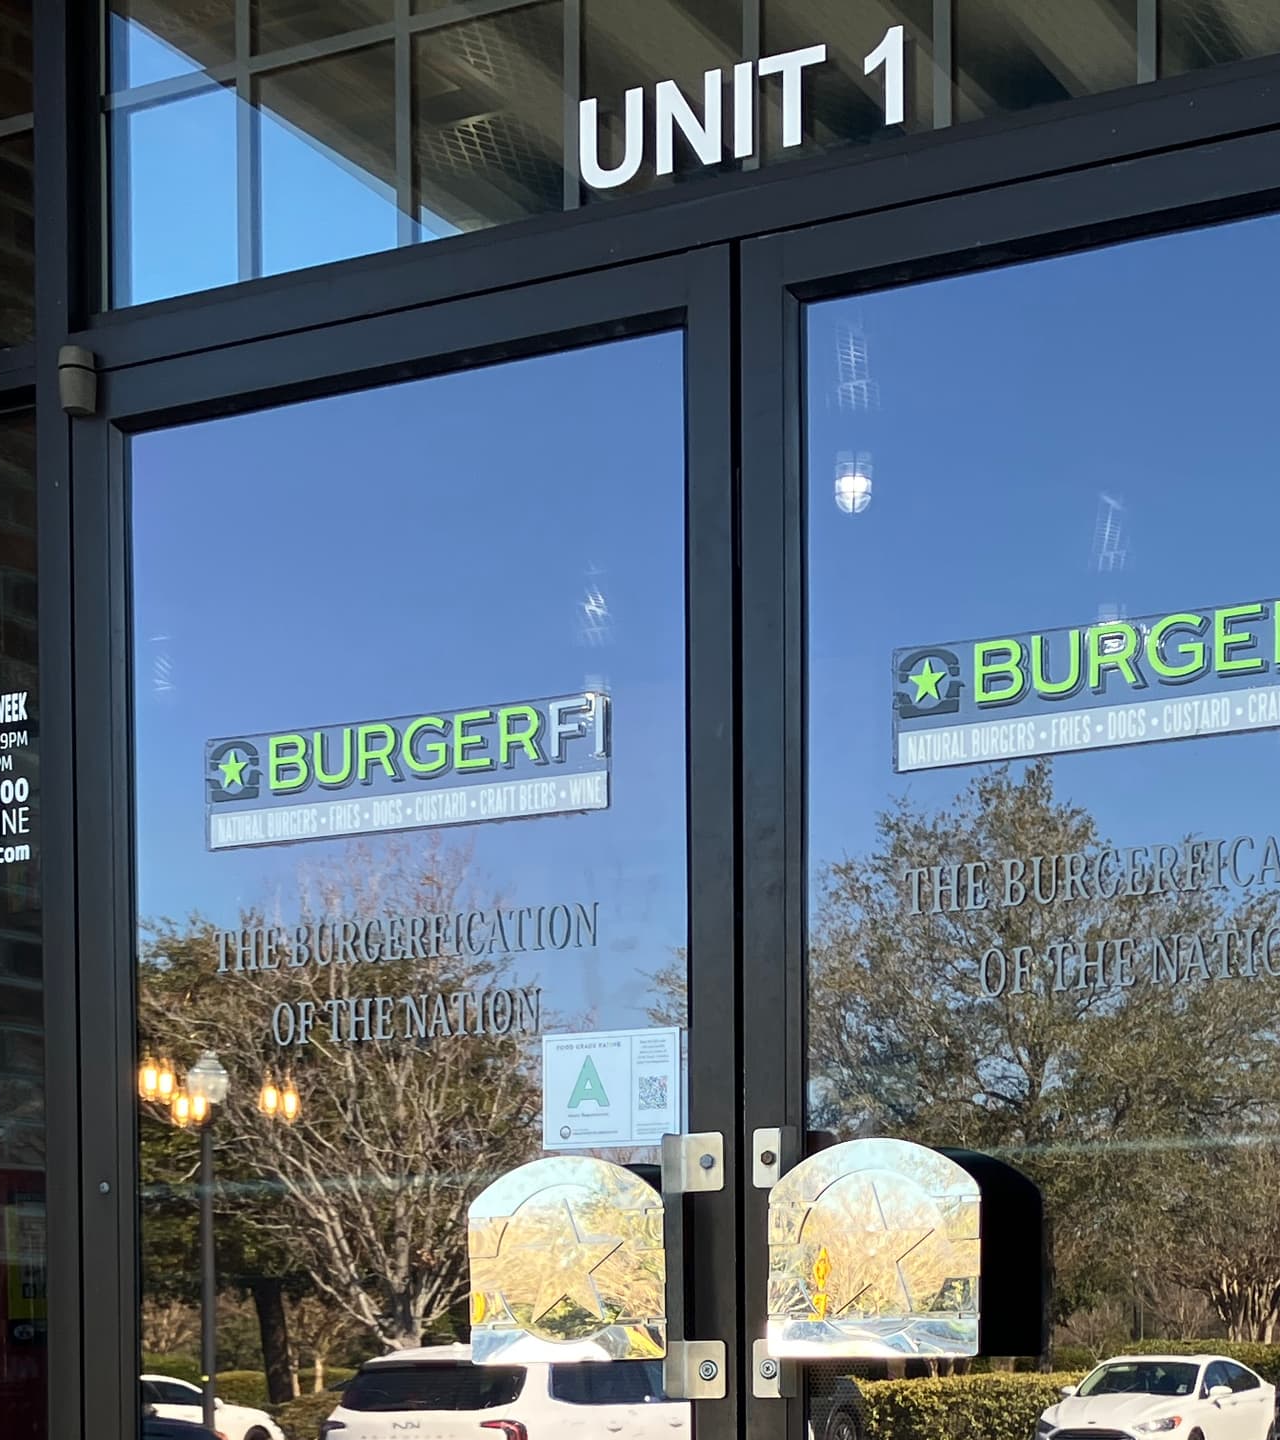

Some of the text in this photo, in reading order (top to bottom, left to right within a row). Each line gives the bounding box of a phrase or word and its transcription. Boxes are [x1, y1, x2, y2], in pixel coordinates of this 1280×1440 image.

[579, 25, 905, 189] UNIT 1
[0, 730, 28, 750] 9PM
[267, 693, 608, 792] BURGERFI
[907, 729, 968, 765] NATURAL
[971, 721, 1036, 757] BURGERS
[1051, 714, 1091, 748] FRIES
[1108, 708, 1147, 741] DOGS
[1163, 699, 1231, 735] CUSTARD
[218, 775, 603, 843] NATURAL BURGERS FRIES DOGS CUSTARD CRAFT BEERS WINE
[905, 860, 989, 917] THE
[212, 901, 601, 974] THE BURGERFICATION
[979, 945, 1034, 1000] OF
[1048, 937, 1138, 993] THE
[271, 987, 543, 1047] OF THE NATION
[567, 1054, 610, 1109] A
